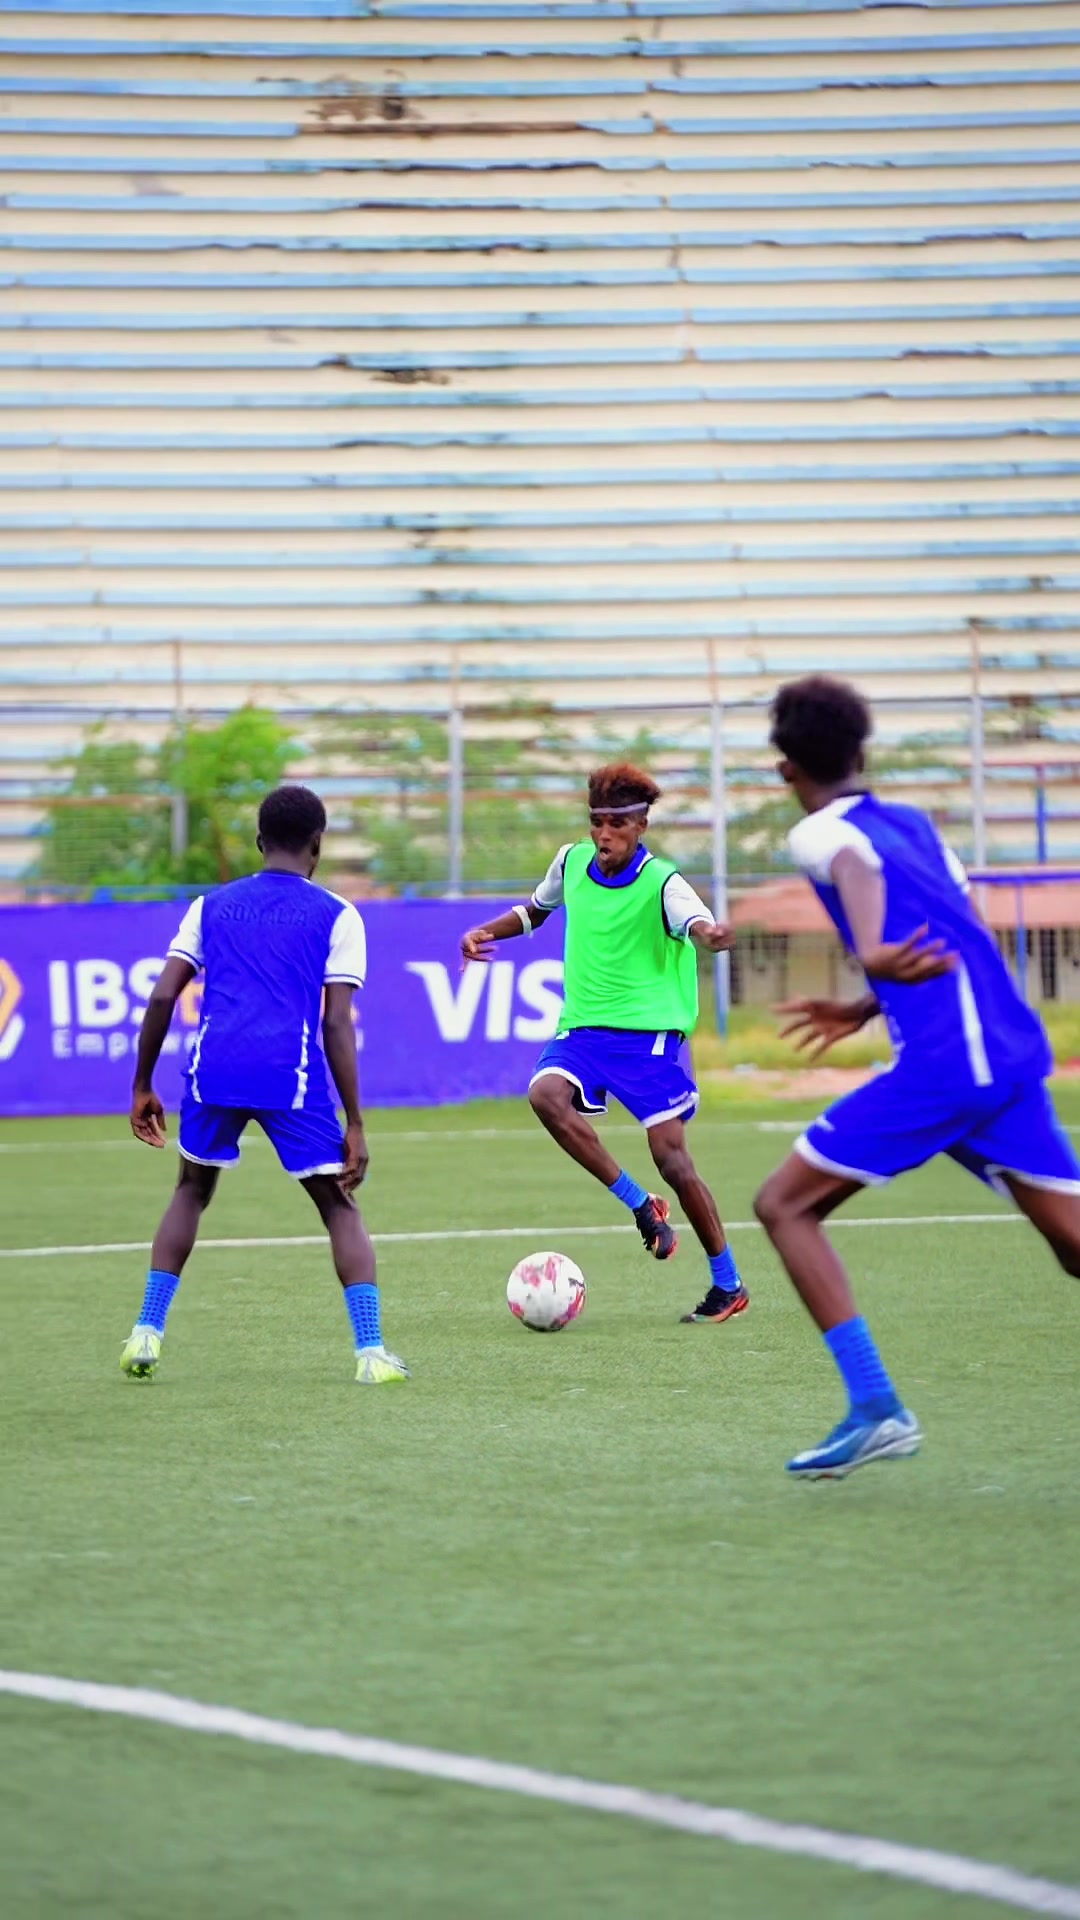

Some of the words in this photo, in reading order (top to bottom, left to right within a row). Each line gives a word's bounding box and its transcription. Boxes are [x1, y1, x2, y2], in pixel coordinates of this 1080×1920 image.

[219, 902, 308, 927] SOMALIA
[49, 957, 204, 1028] IBS
[404, 958, 565, 1043] VIS
